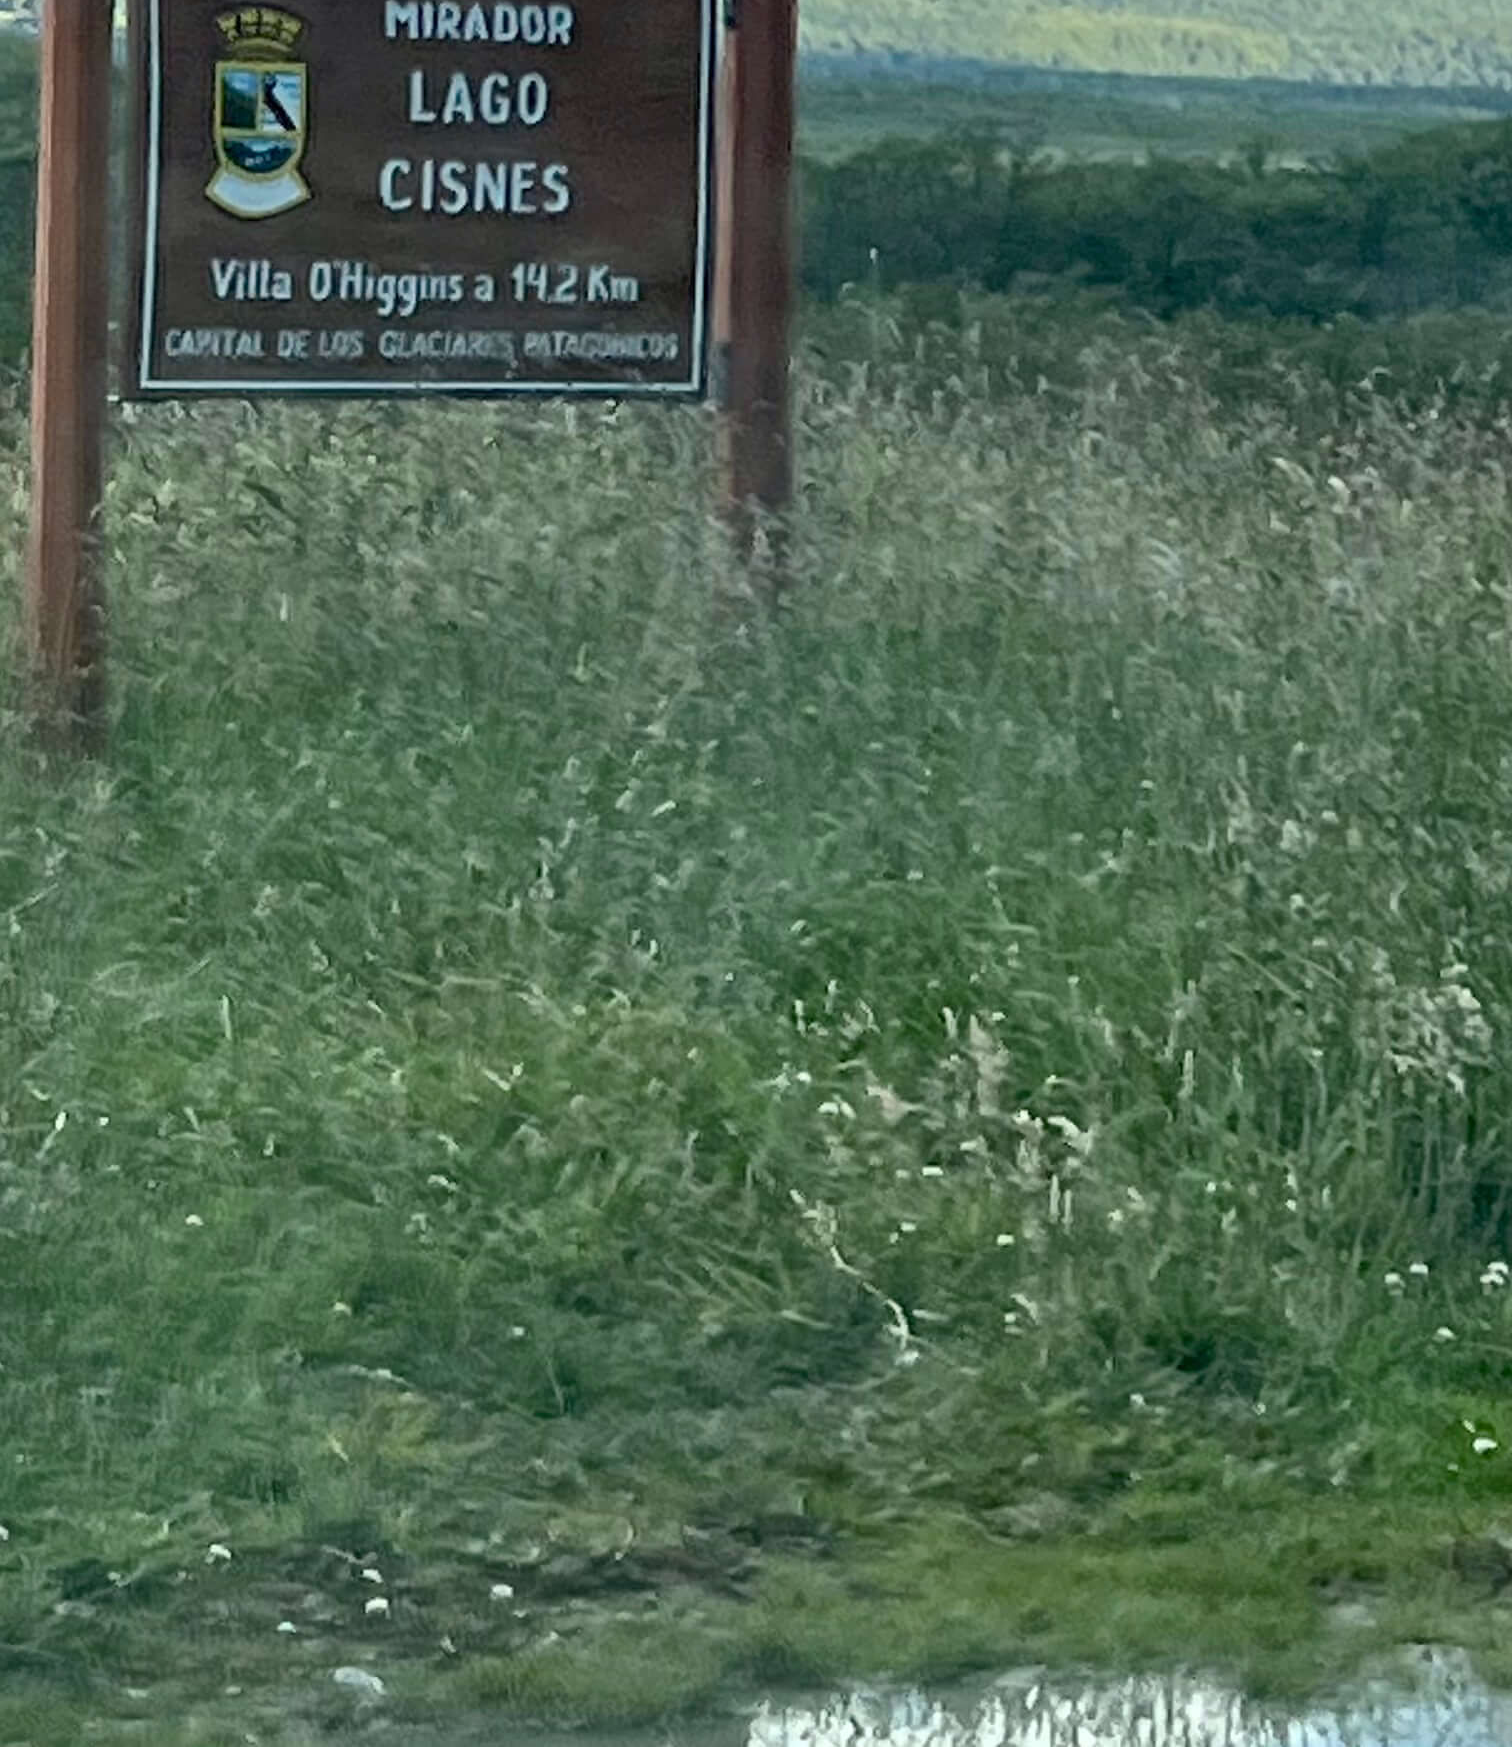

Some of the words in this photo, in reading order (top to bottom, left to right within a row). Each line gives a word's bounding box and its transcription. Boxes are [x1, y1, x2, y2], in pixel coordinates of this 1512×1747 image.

[409, 70, 548, 125] LAGO
[379, 158, 571, 214] CISNES
[210, 257, 293, 301] Villa
[474, 273, 494, 302] a
[587, 262, 639, 303] Km
[164, 328, 264, 357] CAPITAL
[277, 330, 311, 357] DE
[319, 330, 365, 358] LOS
